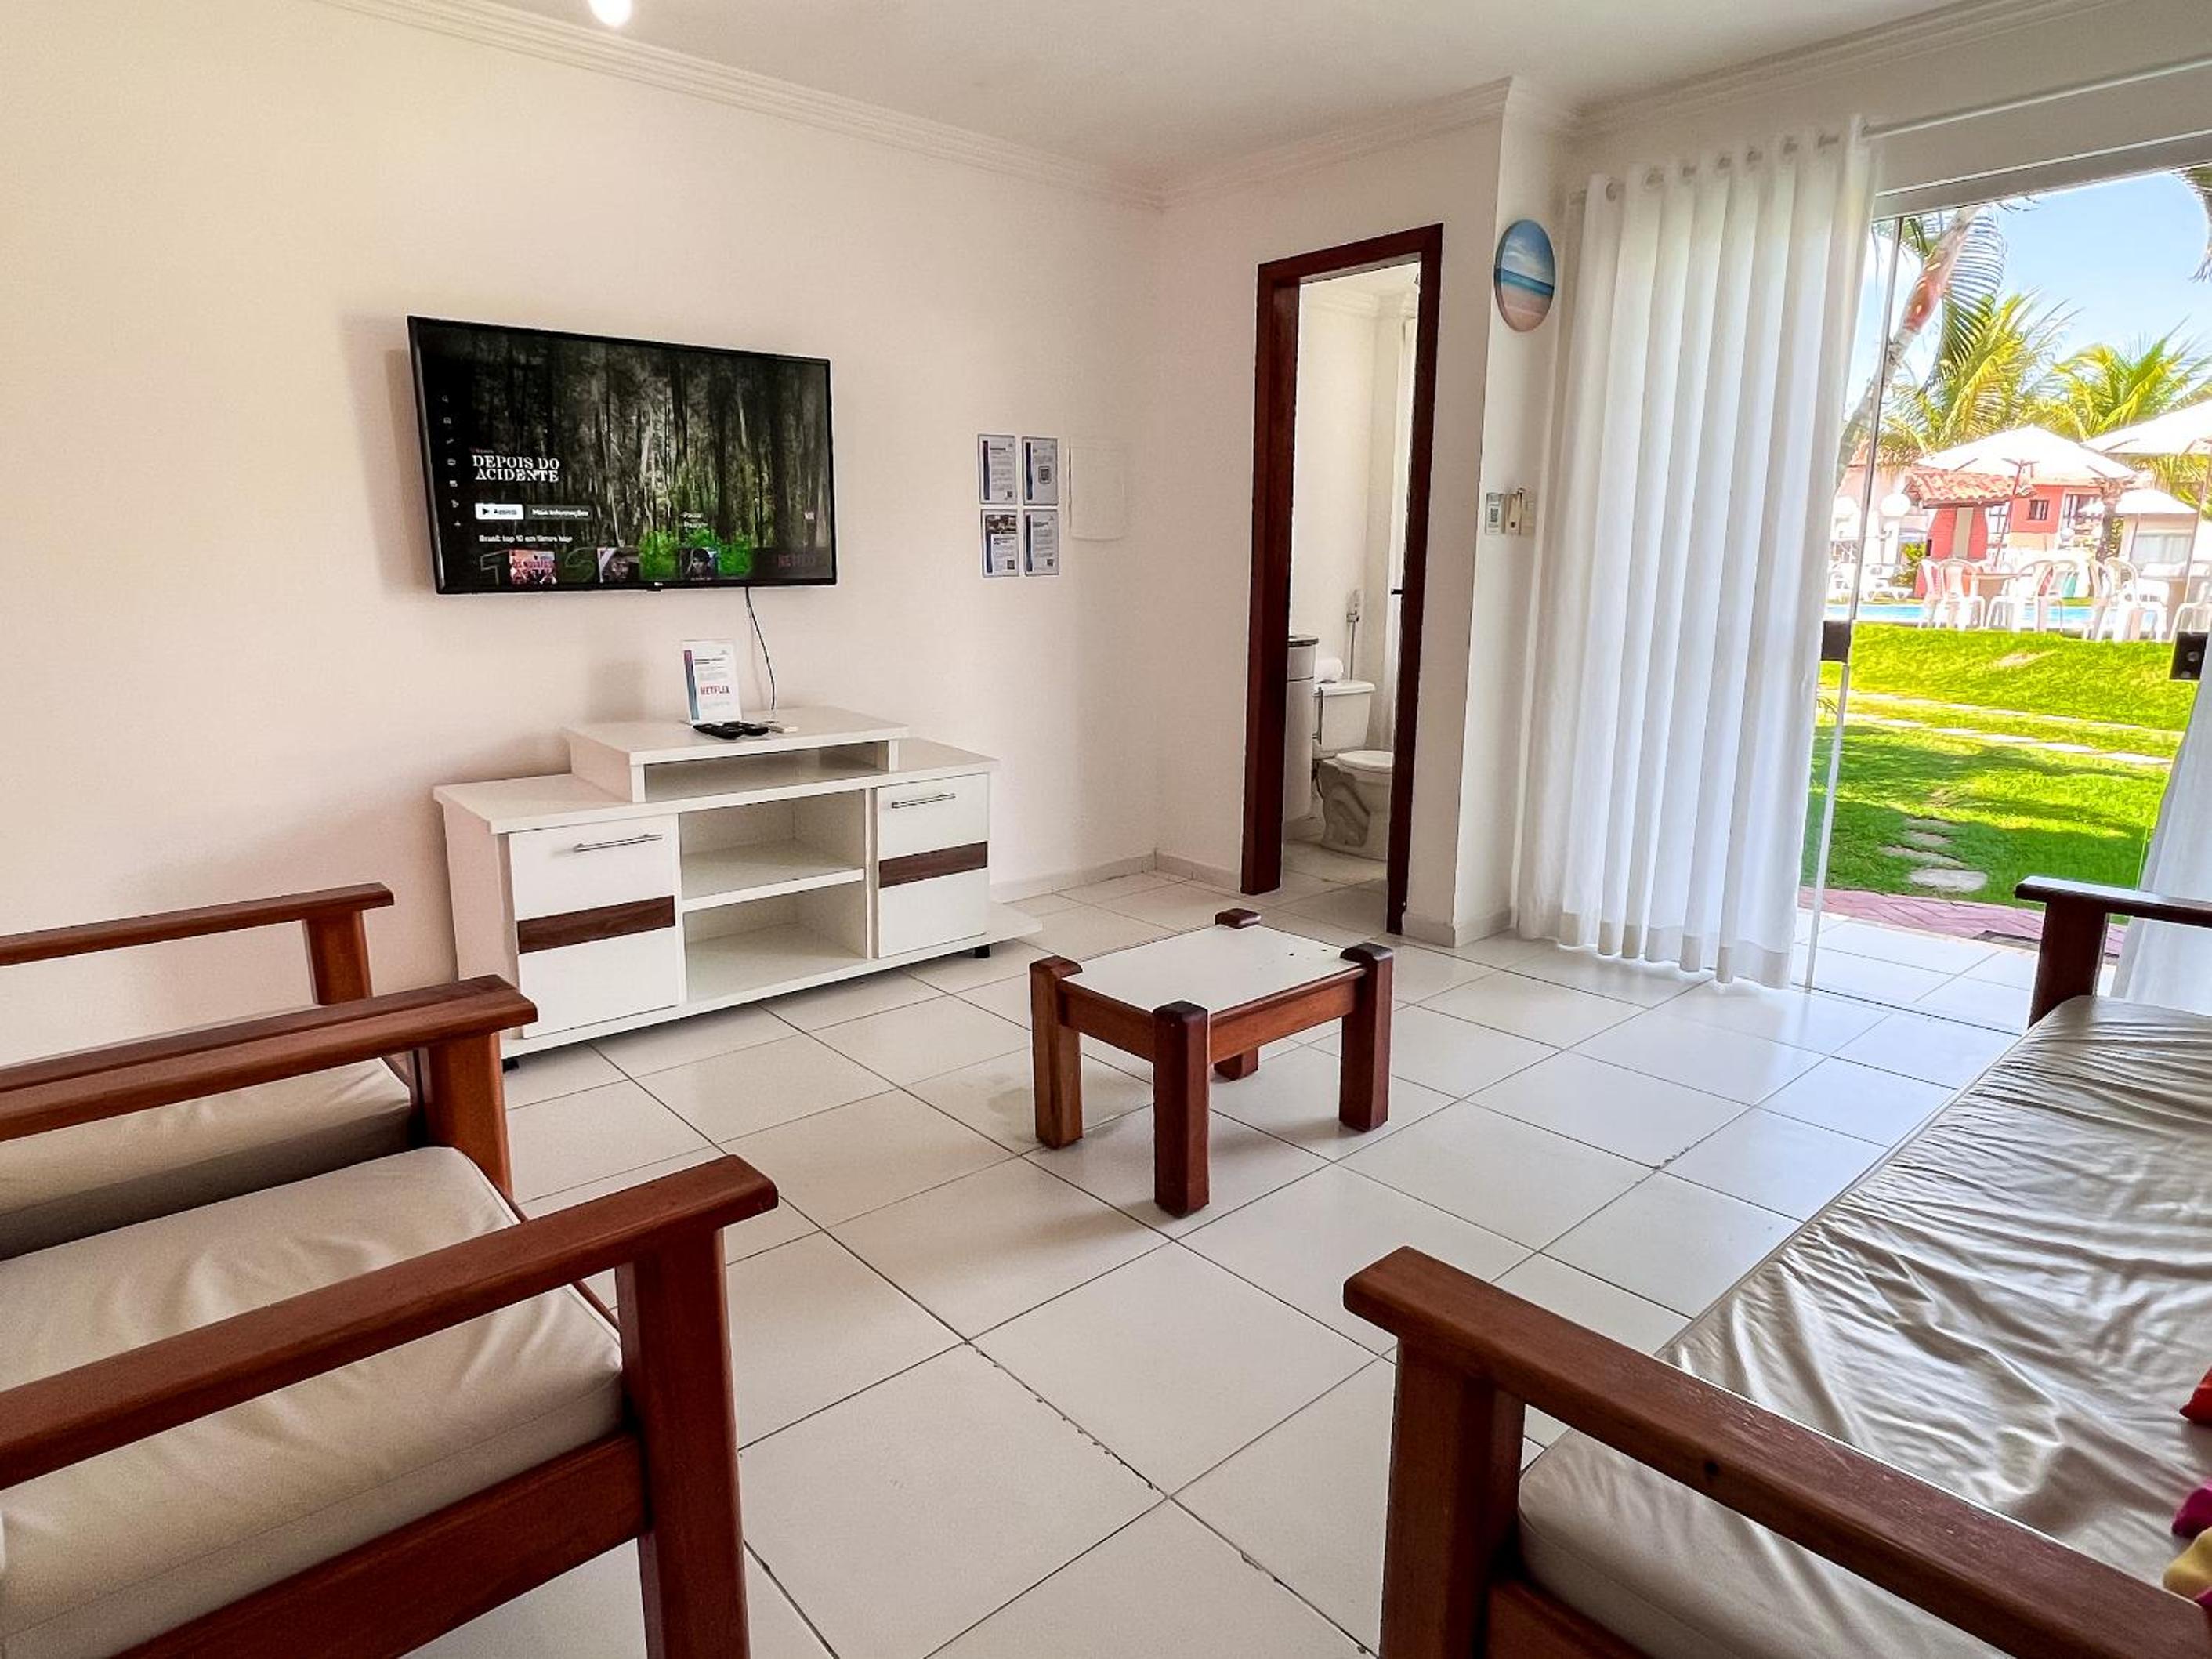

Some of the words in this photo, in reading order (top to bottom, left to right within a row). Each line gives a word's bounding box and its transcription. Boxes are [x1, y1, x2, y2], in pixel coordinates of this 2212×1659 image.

[472, 455, 534, 469] DEPOIS
[538, 458, 559, 470] DO
[474, 467, 559, 483] ACIDENTE
[700, 685, 730, 695] NETFLIX
